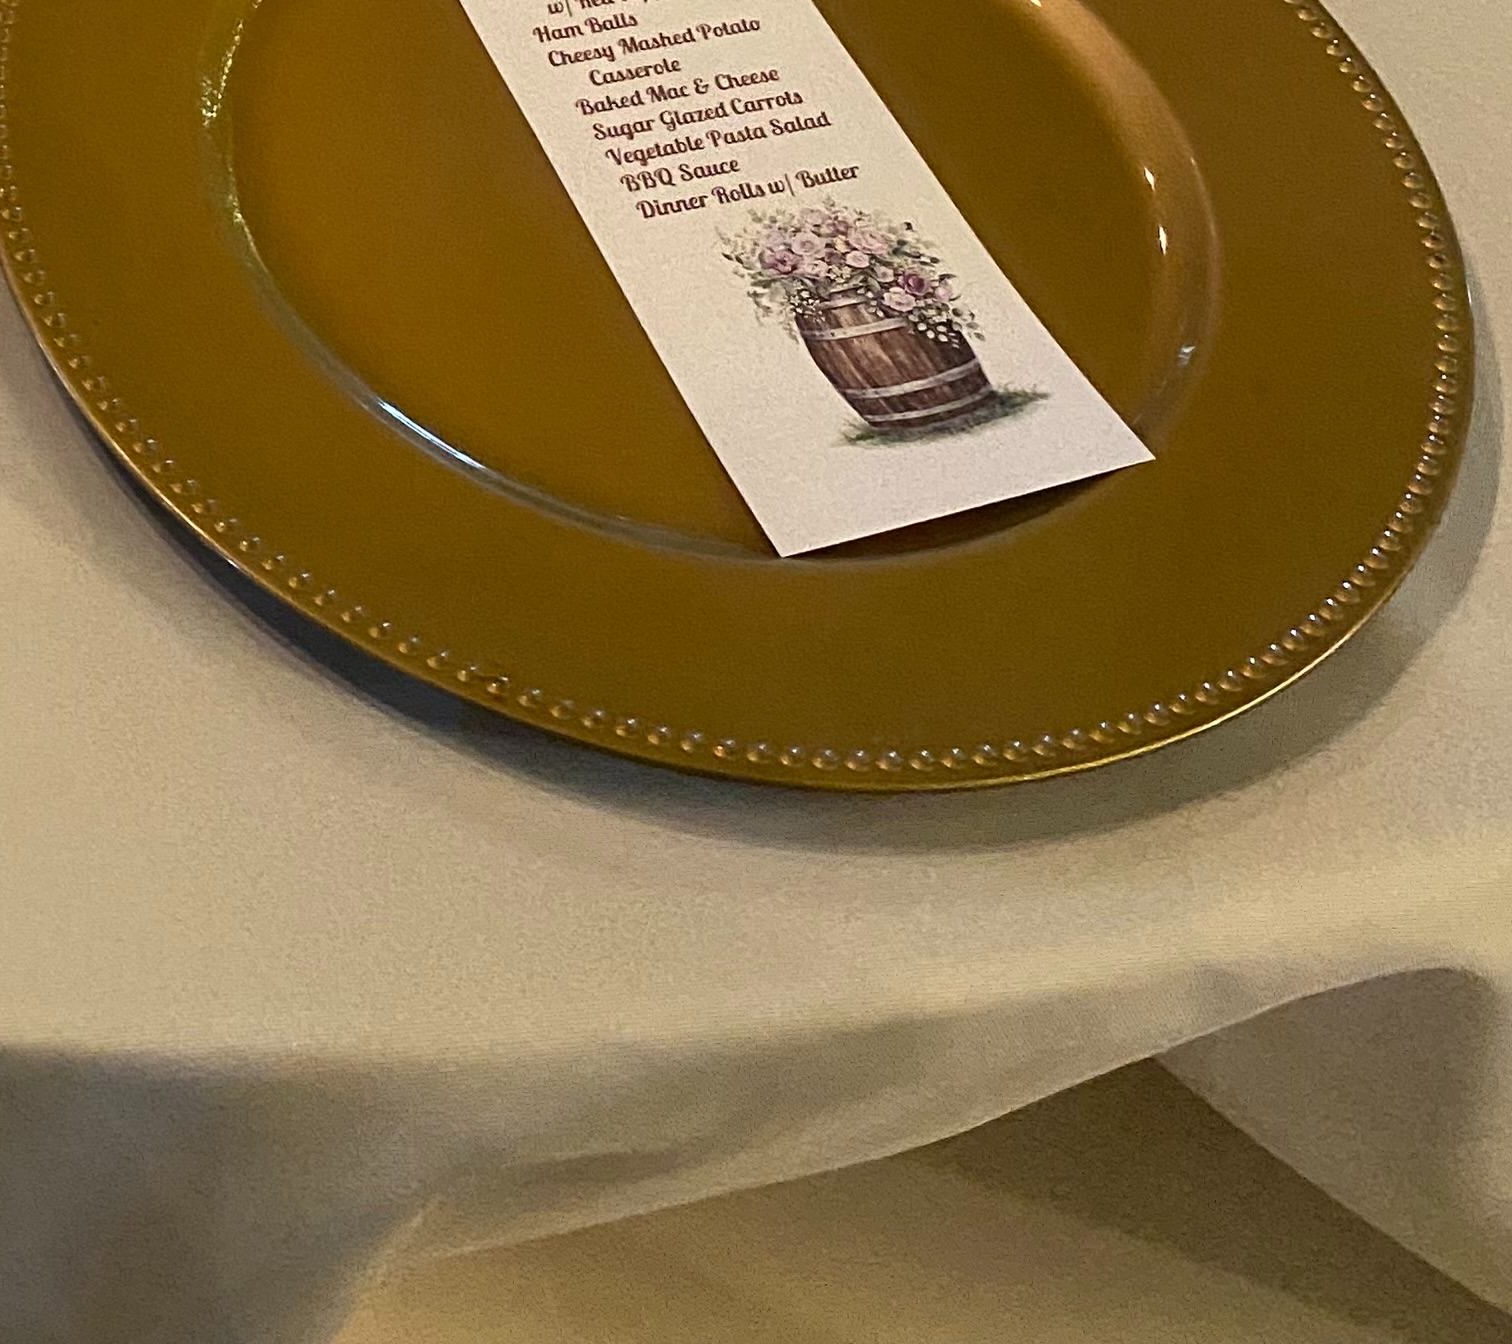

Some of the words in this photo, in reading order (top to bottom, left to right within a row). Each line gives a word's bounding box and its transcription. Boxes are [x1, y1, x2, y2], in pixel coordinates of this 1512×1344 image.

[532, 23, 584, 43] Ham
[584, 12, 638, 34] Balls
[547, 43, 615, 67] Cheesy
[617, 28, 697, 56] Mashed
[696, 19, 761, 41] Potato
[575, 91, 645, 116] Baked
[646, 84, 690, 104] Mac
[693, 77, 710, 95] &
[714, 68, 780, 91] Cheese
[589, 58, 682, 86] Casserole
[592, 118, 656, 141] Sugar
[659, 102, 730, 132] Glazed
[730, 91, 803, 115] Carrots
[605, 135, 705, 167] Vegetable
[705, 123, 768, 148] Pasta
[770, 111, 832, 136] Salad
[620, 166, 677, 193] BBQ
[680, 159, 741, 182] Sauce
[636, 193, 709, 219] Dinner
[711, 181, 766, 205] Rolls
[795, 165, 860, 189] Butter
